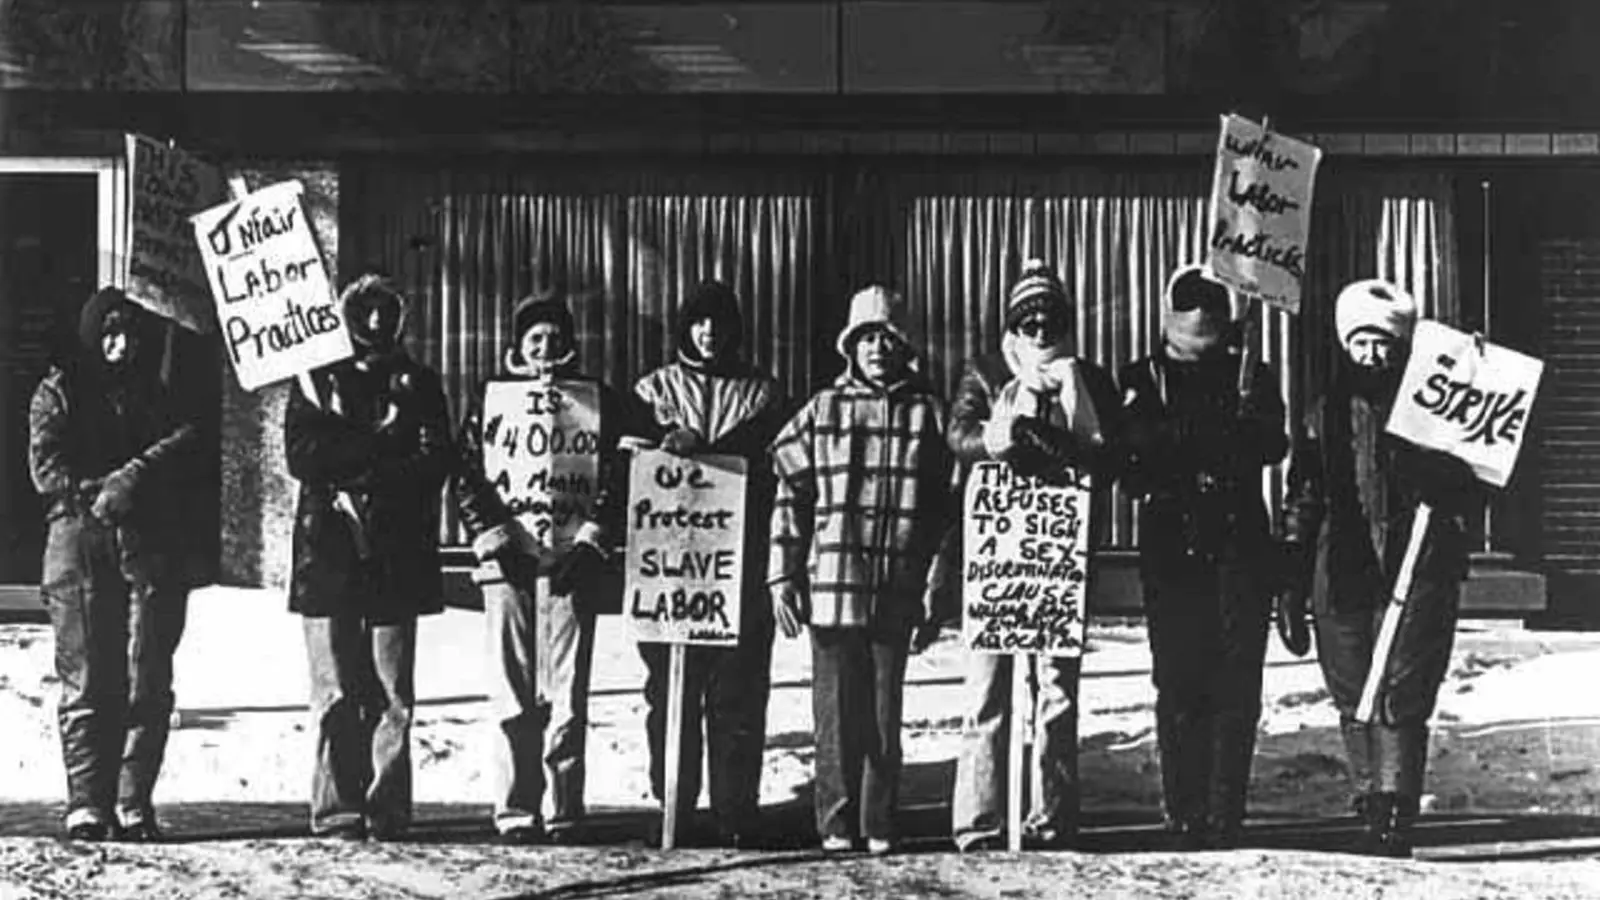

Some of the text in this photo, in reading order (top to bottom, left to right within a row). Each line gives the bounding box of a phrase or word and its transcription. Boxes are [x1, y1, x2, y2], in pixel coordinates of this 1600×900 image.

[527, 390, 563, 415] IS
[1413, 373, 1528, 446] STRIKE
[974, 488, 1078, 518] REFUSES
[971, 514, 1081, 539] TO SIGN
[979, 536, 997, 556] A
[640, 550, 735, 580] SLAVE
[982, 581, 1079, 605] CLAUSE
[632, 588, 730, 628] LABOR
